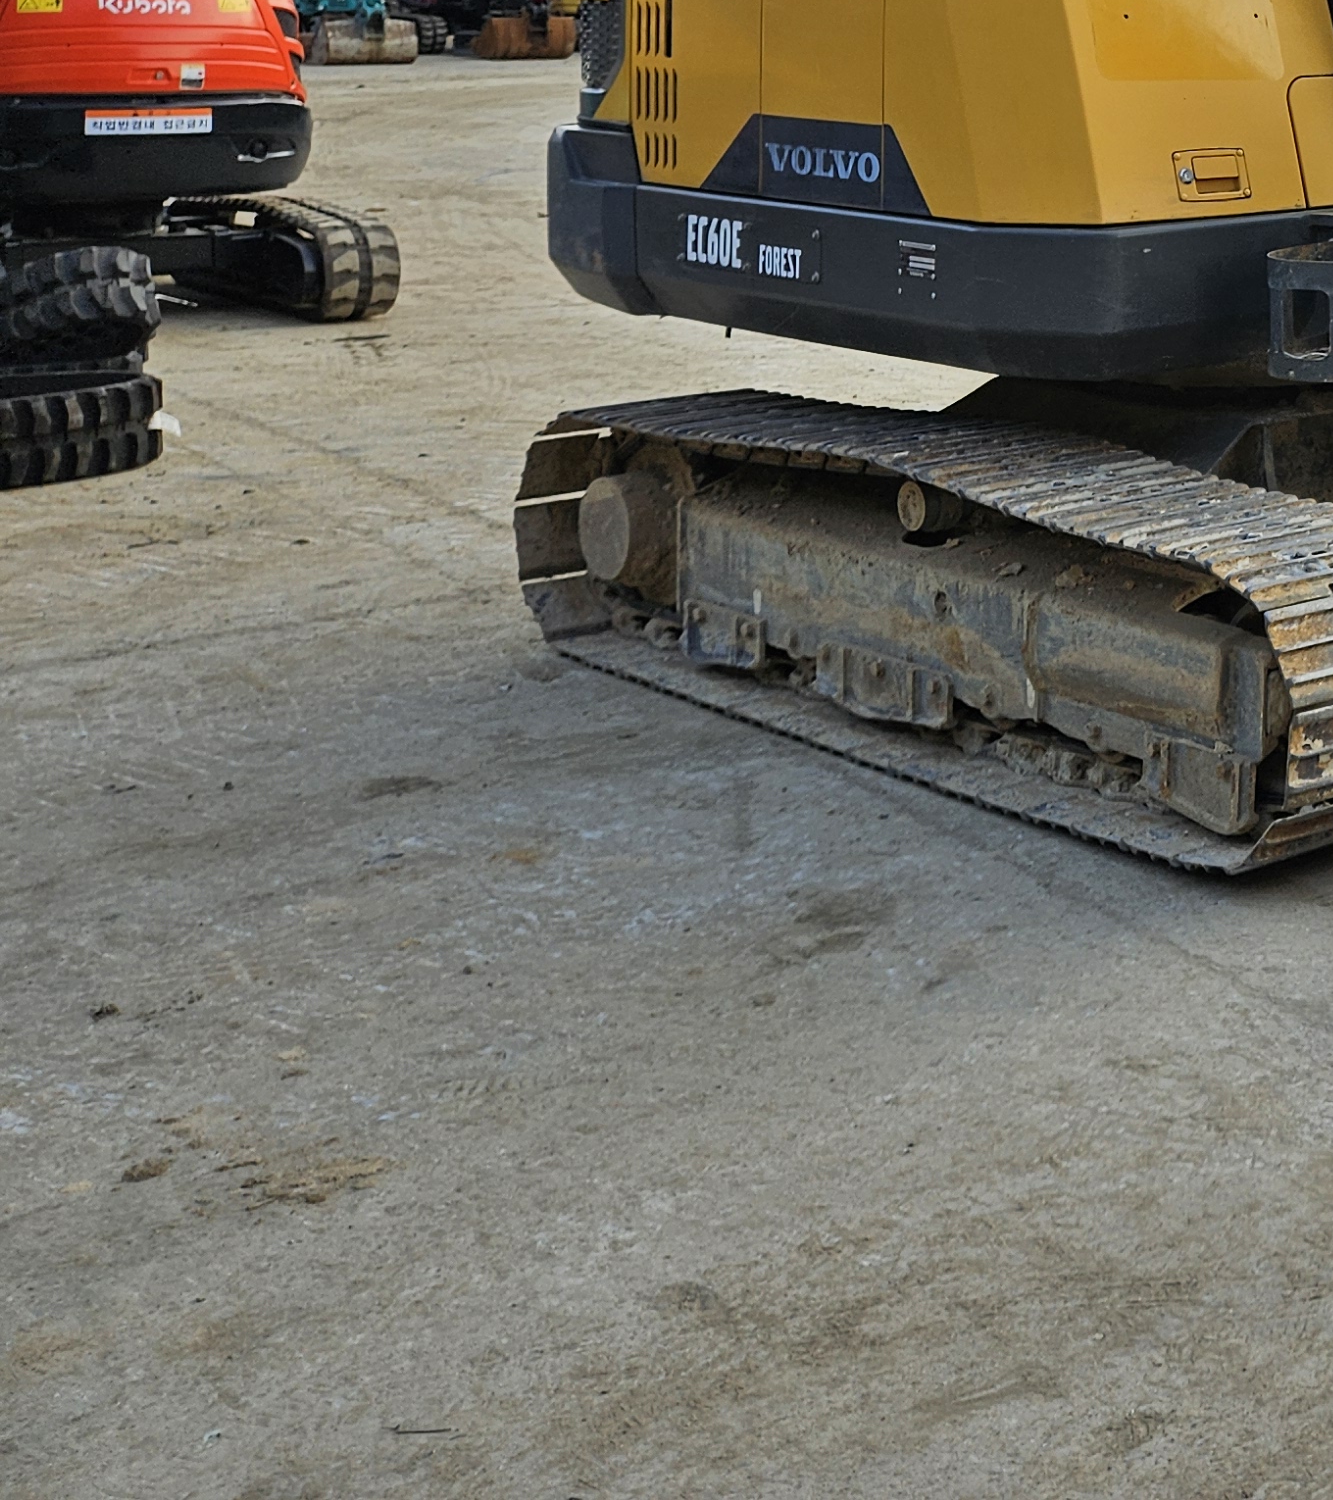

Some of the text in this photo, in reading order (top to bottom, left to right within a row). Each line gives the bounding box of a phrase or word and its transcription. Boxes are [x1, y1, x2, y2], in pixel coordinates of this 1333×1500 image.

[765, 142, 880, 183] VOLVO
[686, 214, 802, 279] EC60E FOREST
